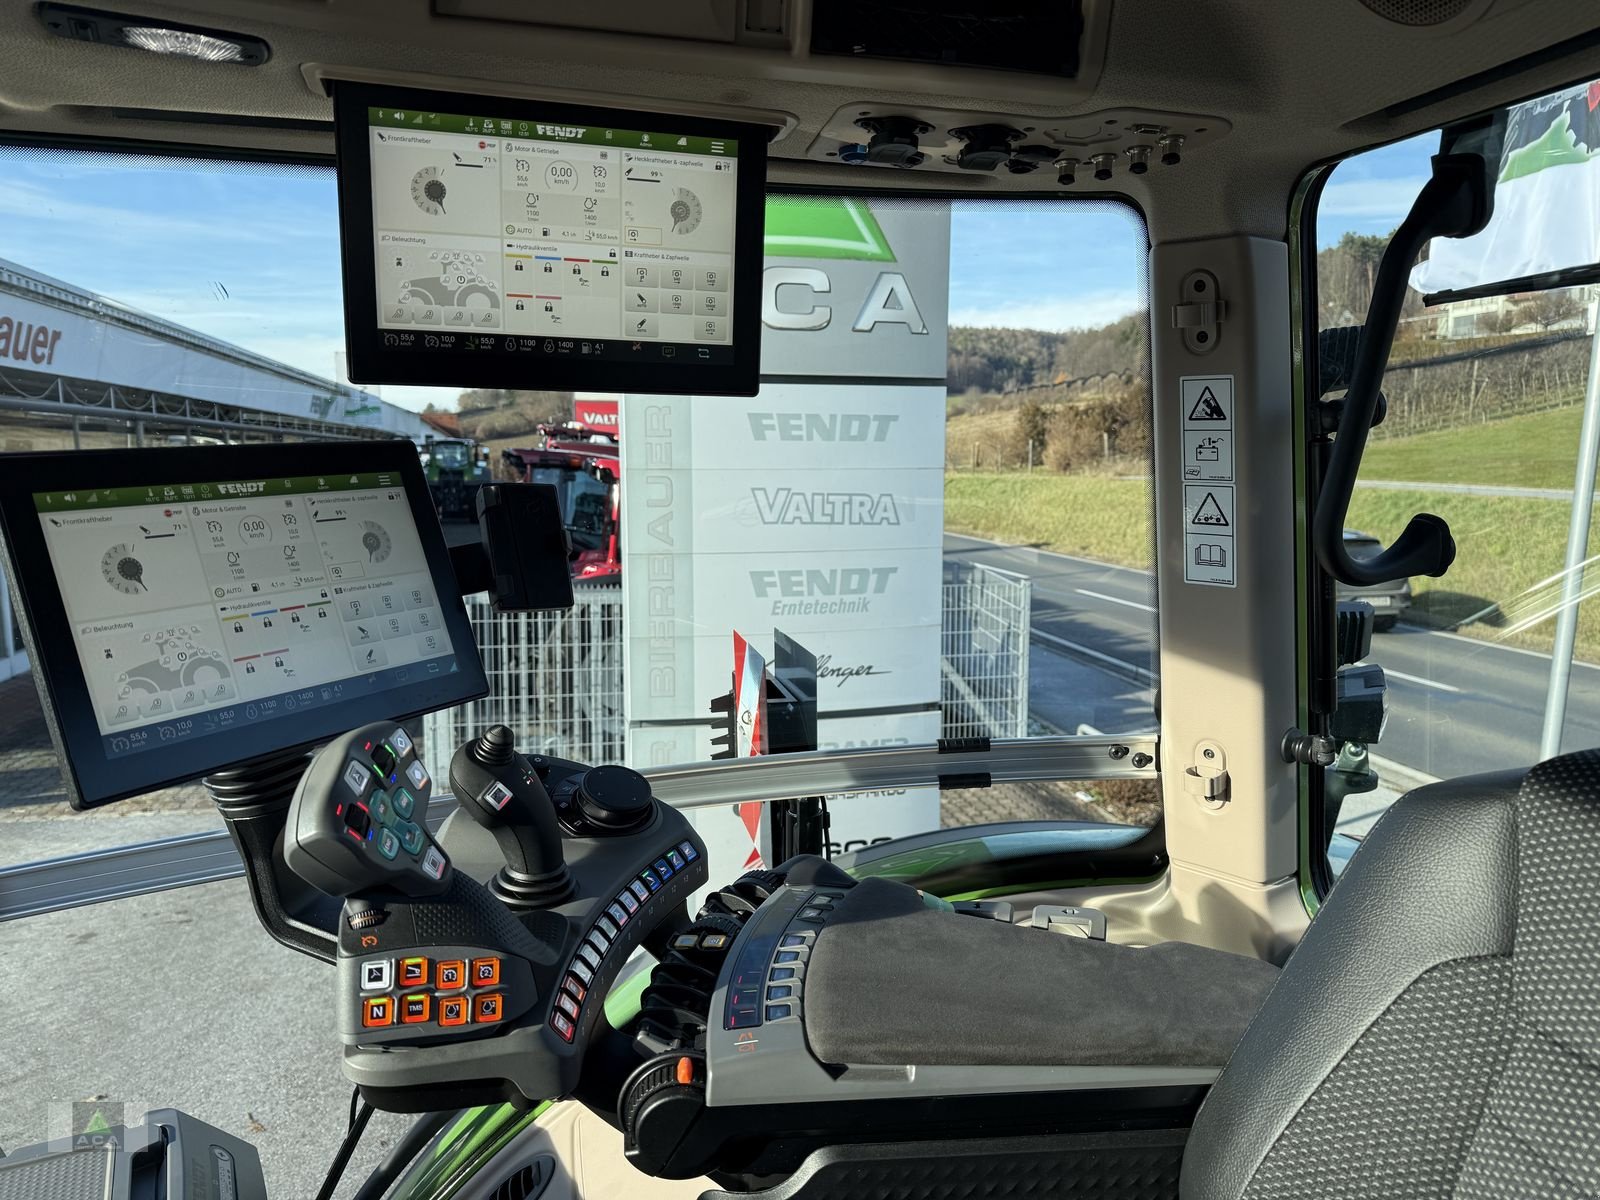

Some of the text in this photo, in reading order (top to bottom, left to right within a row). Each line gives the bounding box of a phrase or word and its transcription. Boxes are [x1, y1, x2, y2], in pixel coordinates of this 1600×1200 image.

[536, 124, 587, 138] FENDT
[551, 166, 572, 178] 0,00
[392, 236, 426, 244] Beleuchtung
[516, 244, 558, 252] Hydraulikventile
[748, 412, 899, 442] FENDT
[218, 482, 266, 494] FENDT
[751, 488, 900, 525] VALTRA
[244, 520, 265, 532] 0,00
[644, 404, 676, 698] BIERBAUER
[748, 566, 898, 598] FENDT
[771, 598, 870, 616] Erntetechnik
[94, 622, 134, 633] Beleuchtung
[260, 700, 277, 710] 1100
[176, 720, 192, 730] 10,0
[130, 732, 148, 742] 55,6
[372, 1006, 384, 1018] N
